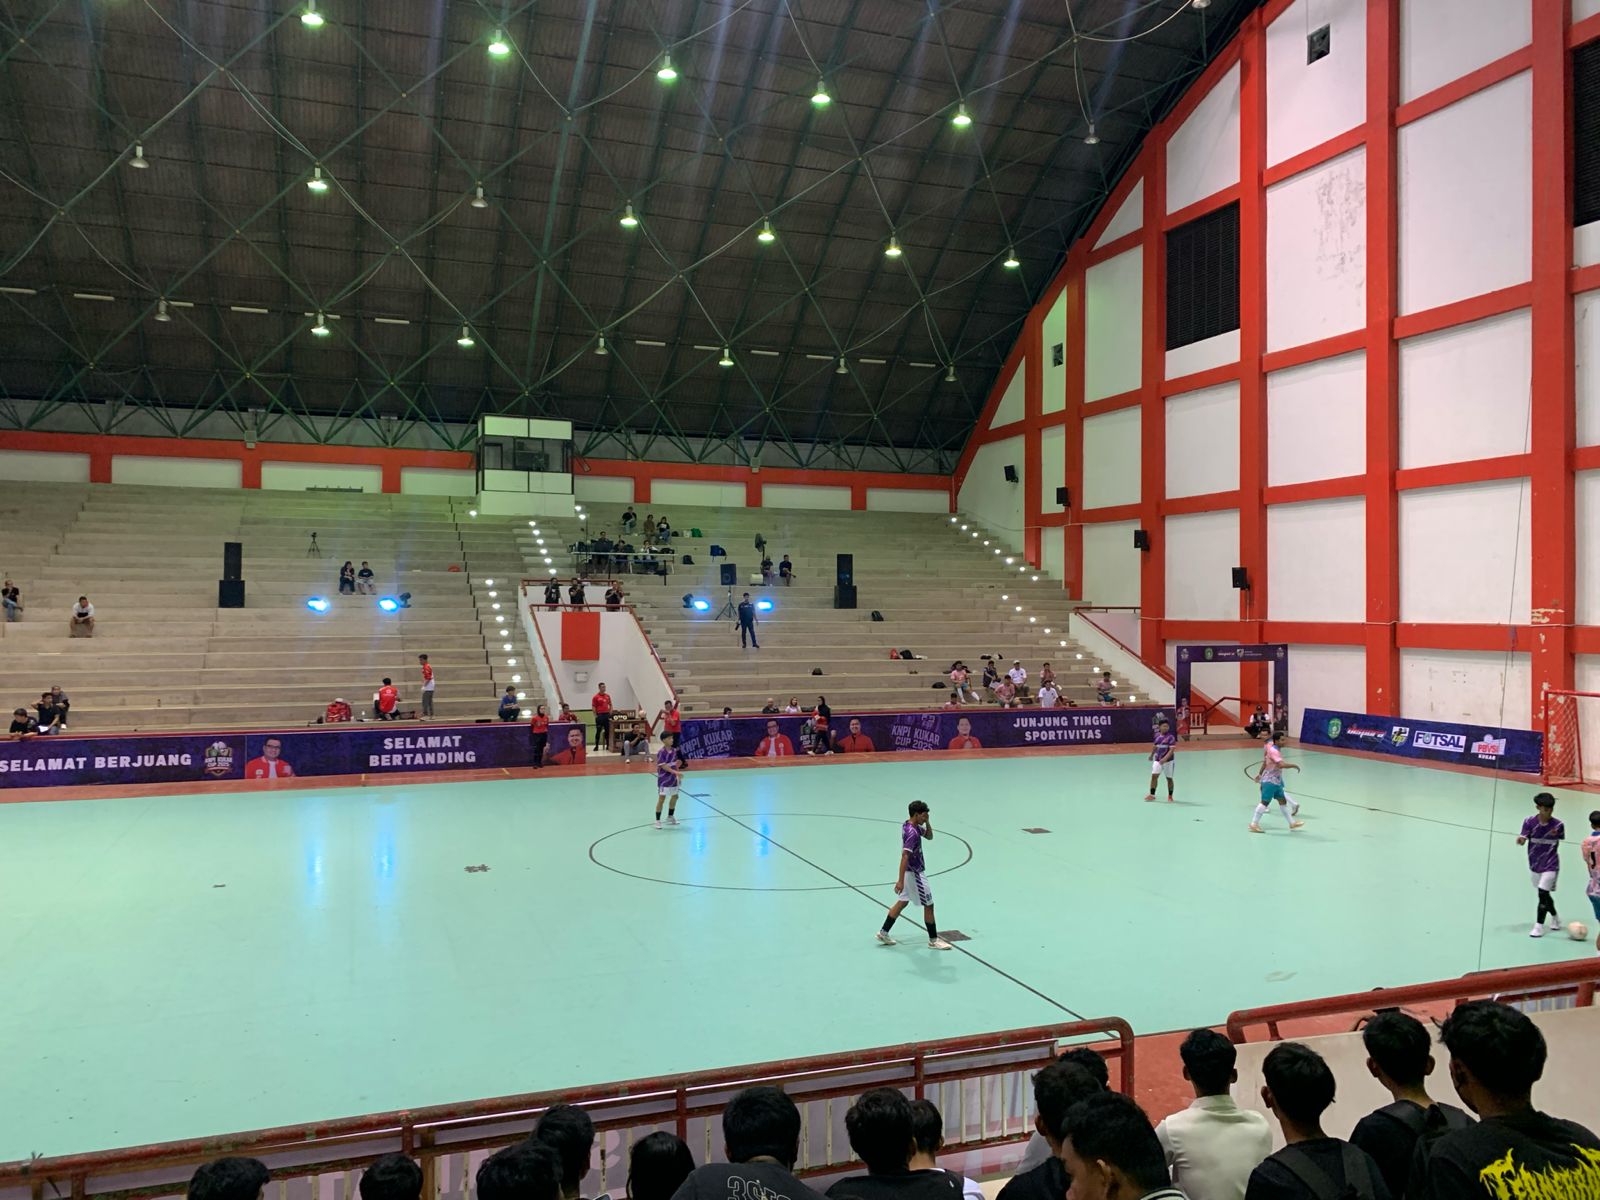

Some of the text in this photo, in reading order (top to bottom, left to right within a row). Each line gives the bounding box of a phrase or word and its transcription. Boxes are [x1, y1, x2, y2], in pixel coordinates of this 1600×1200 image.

[1013, 715, 1112, 727] JUNJUNG TINGGI
[383, 735, 462, 750] SELAMAT
[680, 729, 734, 756] KNPI KUKAR
[891, 725, 940, 746] KNPI KUKAR
[1024, 729, 1102, 741] SPORTIVITAS
[1415, 733, 1463, 748] FUTSAL
[688, 742, 730, 759] CUP 2025
[895, 736, 911, 747] CUP
[912, 739, 933, 751] 2025
[0, 753, 192, 773] SELAMAT BERJUANG
[369, 750, 476, 767] BERTANDING
